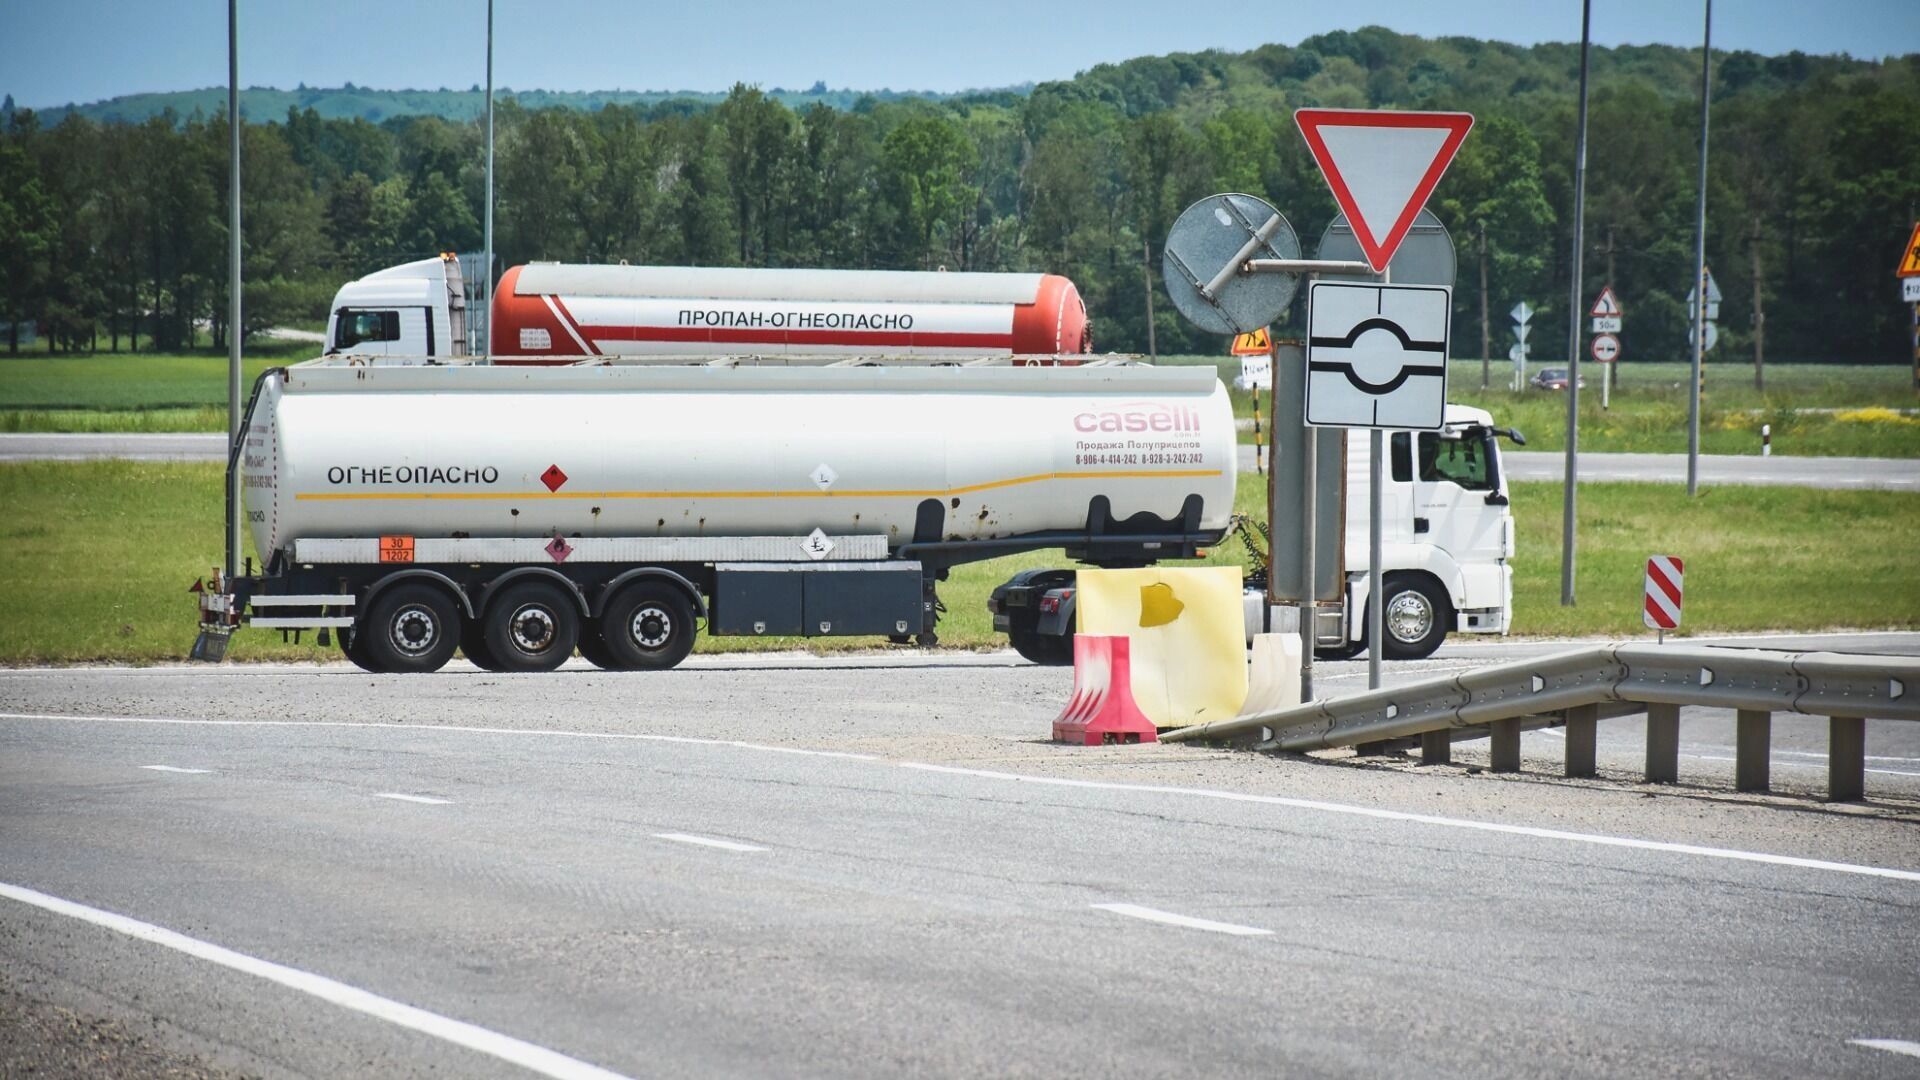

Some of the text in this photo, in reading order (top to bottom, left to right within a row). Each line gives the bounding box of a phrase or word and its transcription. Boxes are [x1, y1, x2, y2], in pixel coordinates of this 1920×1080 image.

[678, 310, 914, 330] ПРОПАН-ОГНЕОПАСНО
[1073, 405, 1201, 433] caselli
[1076, 439, 1201, 451] Продажа Полуприцепов
[327, 465, 499, 485] ОГНЕОПАСНО
[391, 538, 404, 548] 30
[385, 550, 409, 561] 1202
